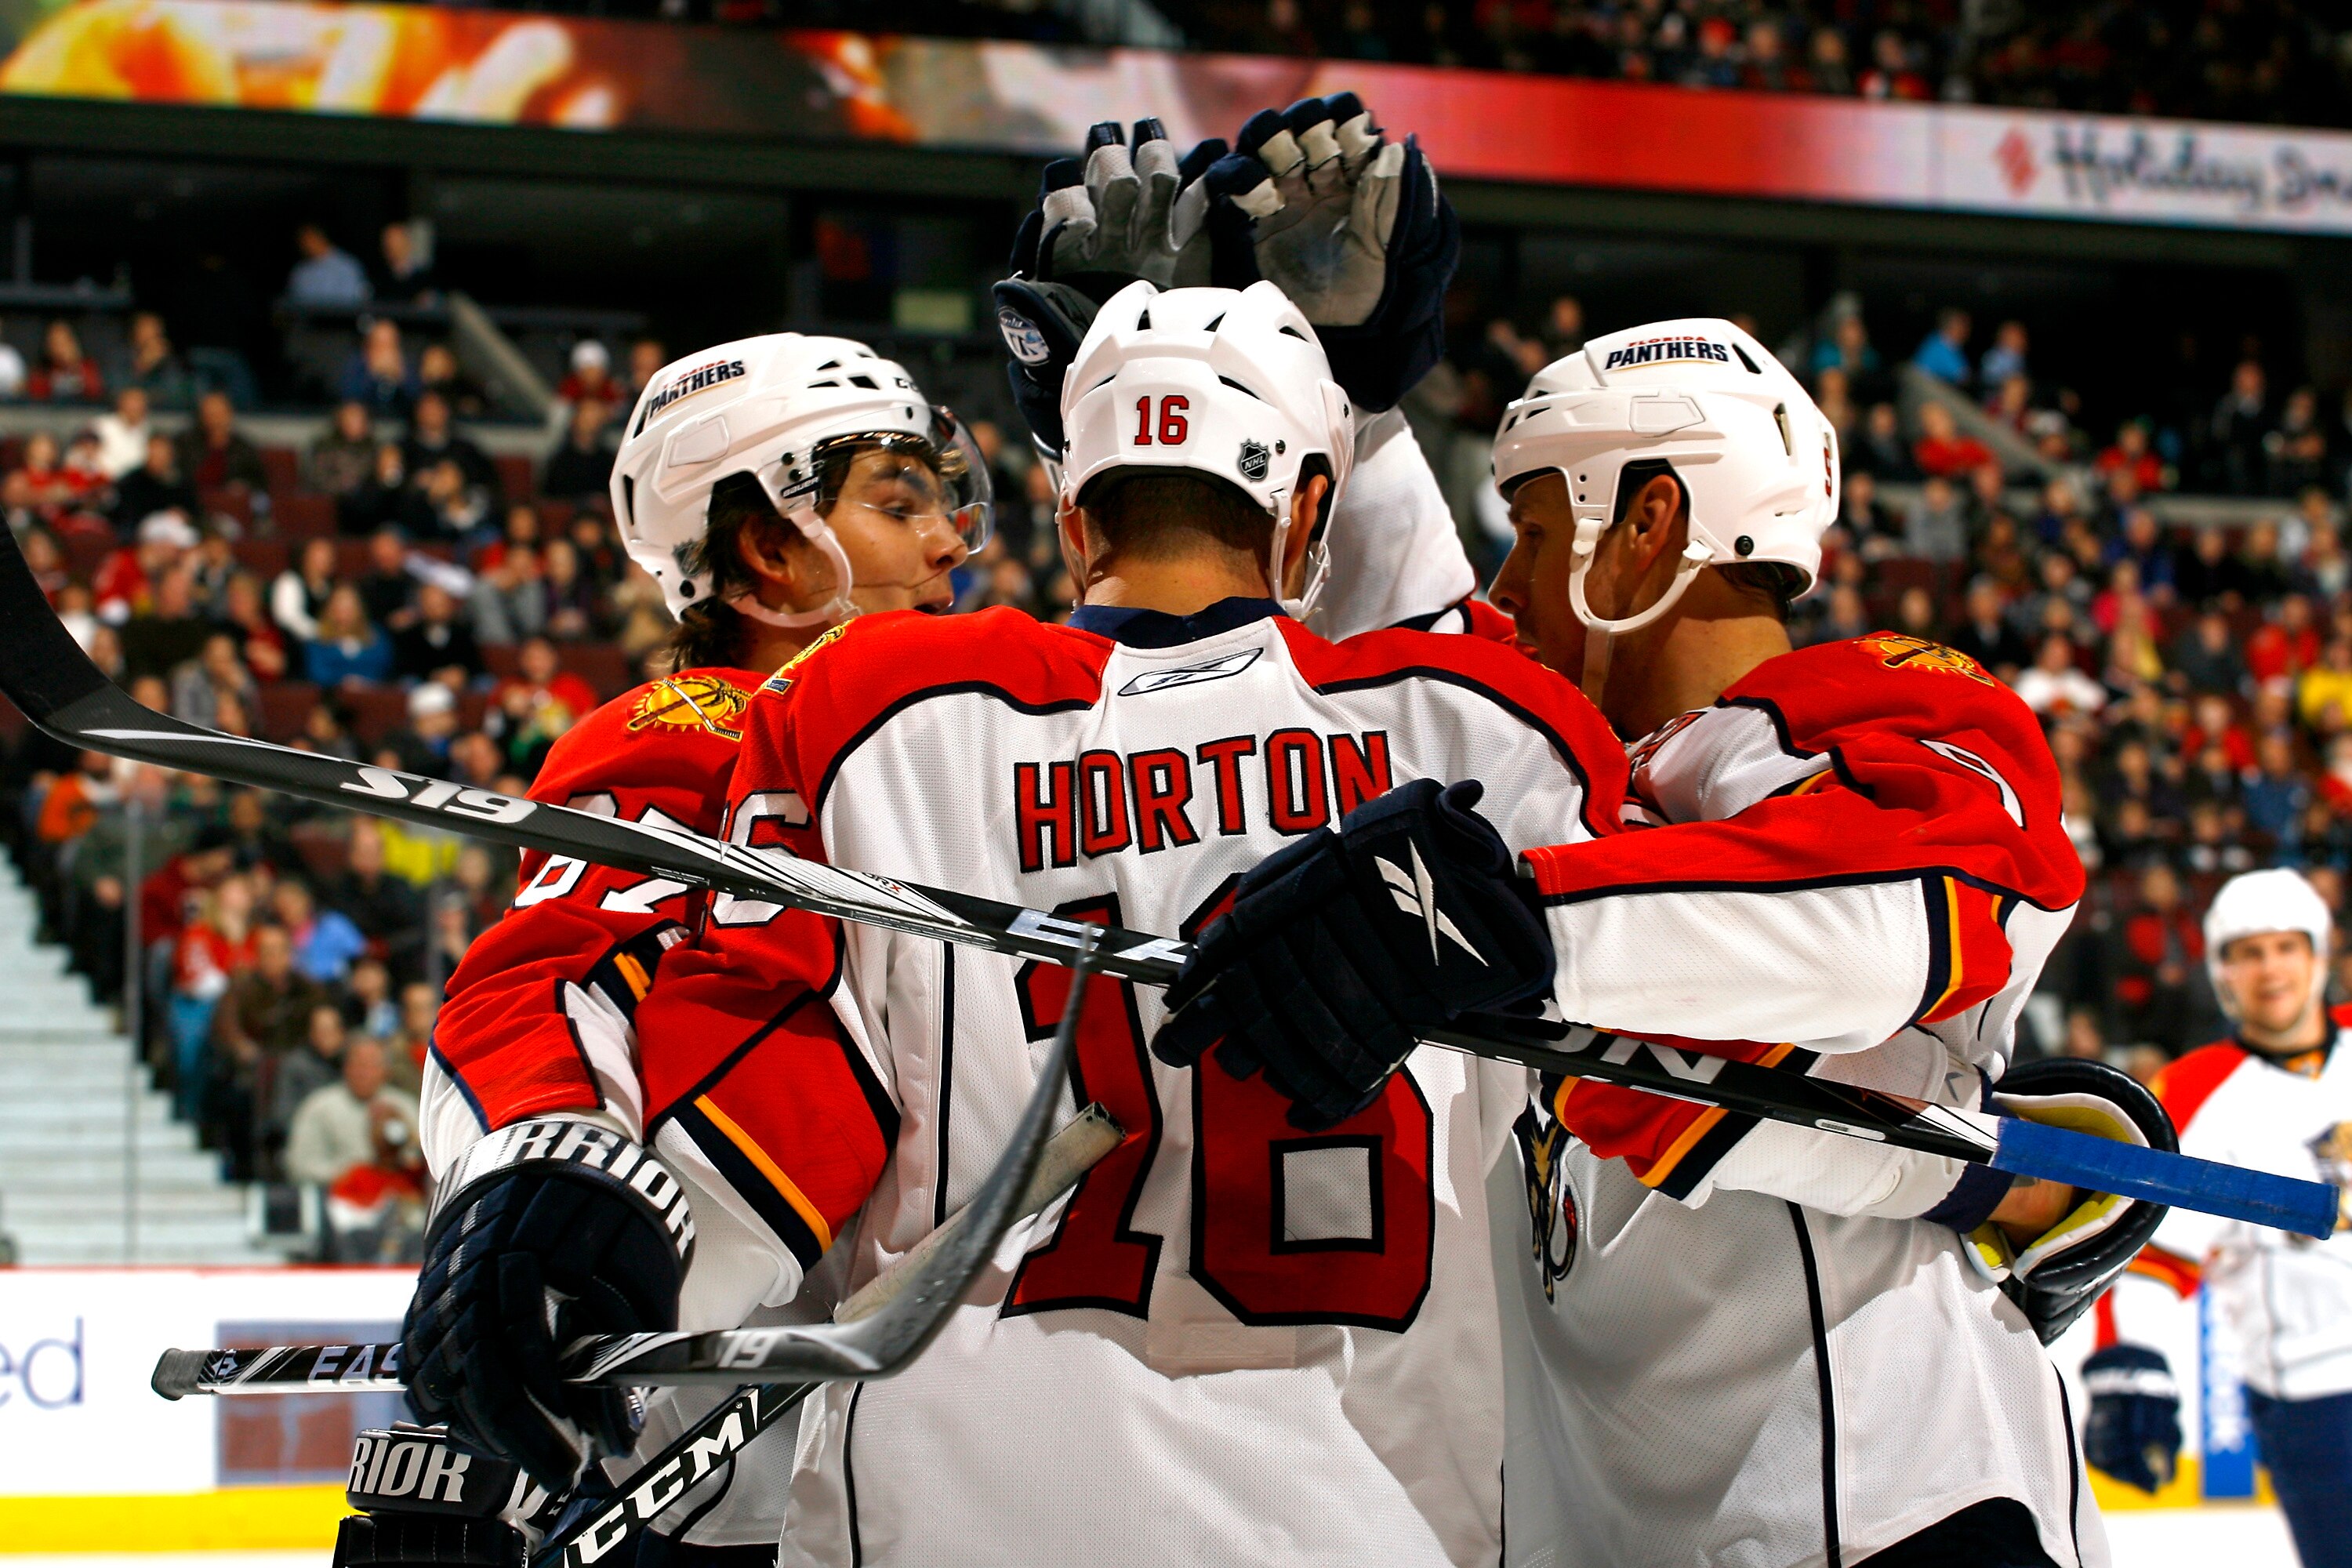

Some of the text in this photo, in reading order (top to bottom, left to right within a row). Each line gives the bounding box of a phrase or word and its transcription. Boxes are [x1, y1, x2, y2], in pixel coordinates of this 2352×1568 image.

[1604, 342, 1729, 370] PANTHERS
[648, 361, 746, 419] PANTHERS
[1134, 395, 1189, 445] 16
[1244, 455, 1265, 470] NHL
[339, 767, 538, 823] S19
[1014, 727, 1393, 873] HORTON
[569, 1412, 744, 1563] CCM
